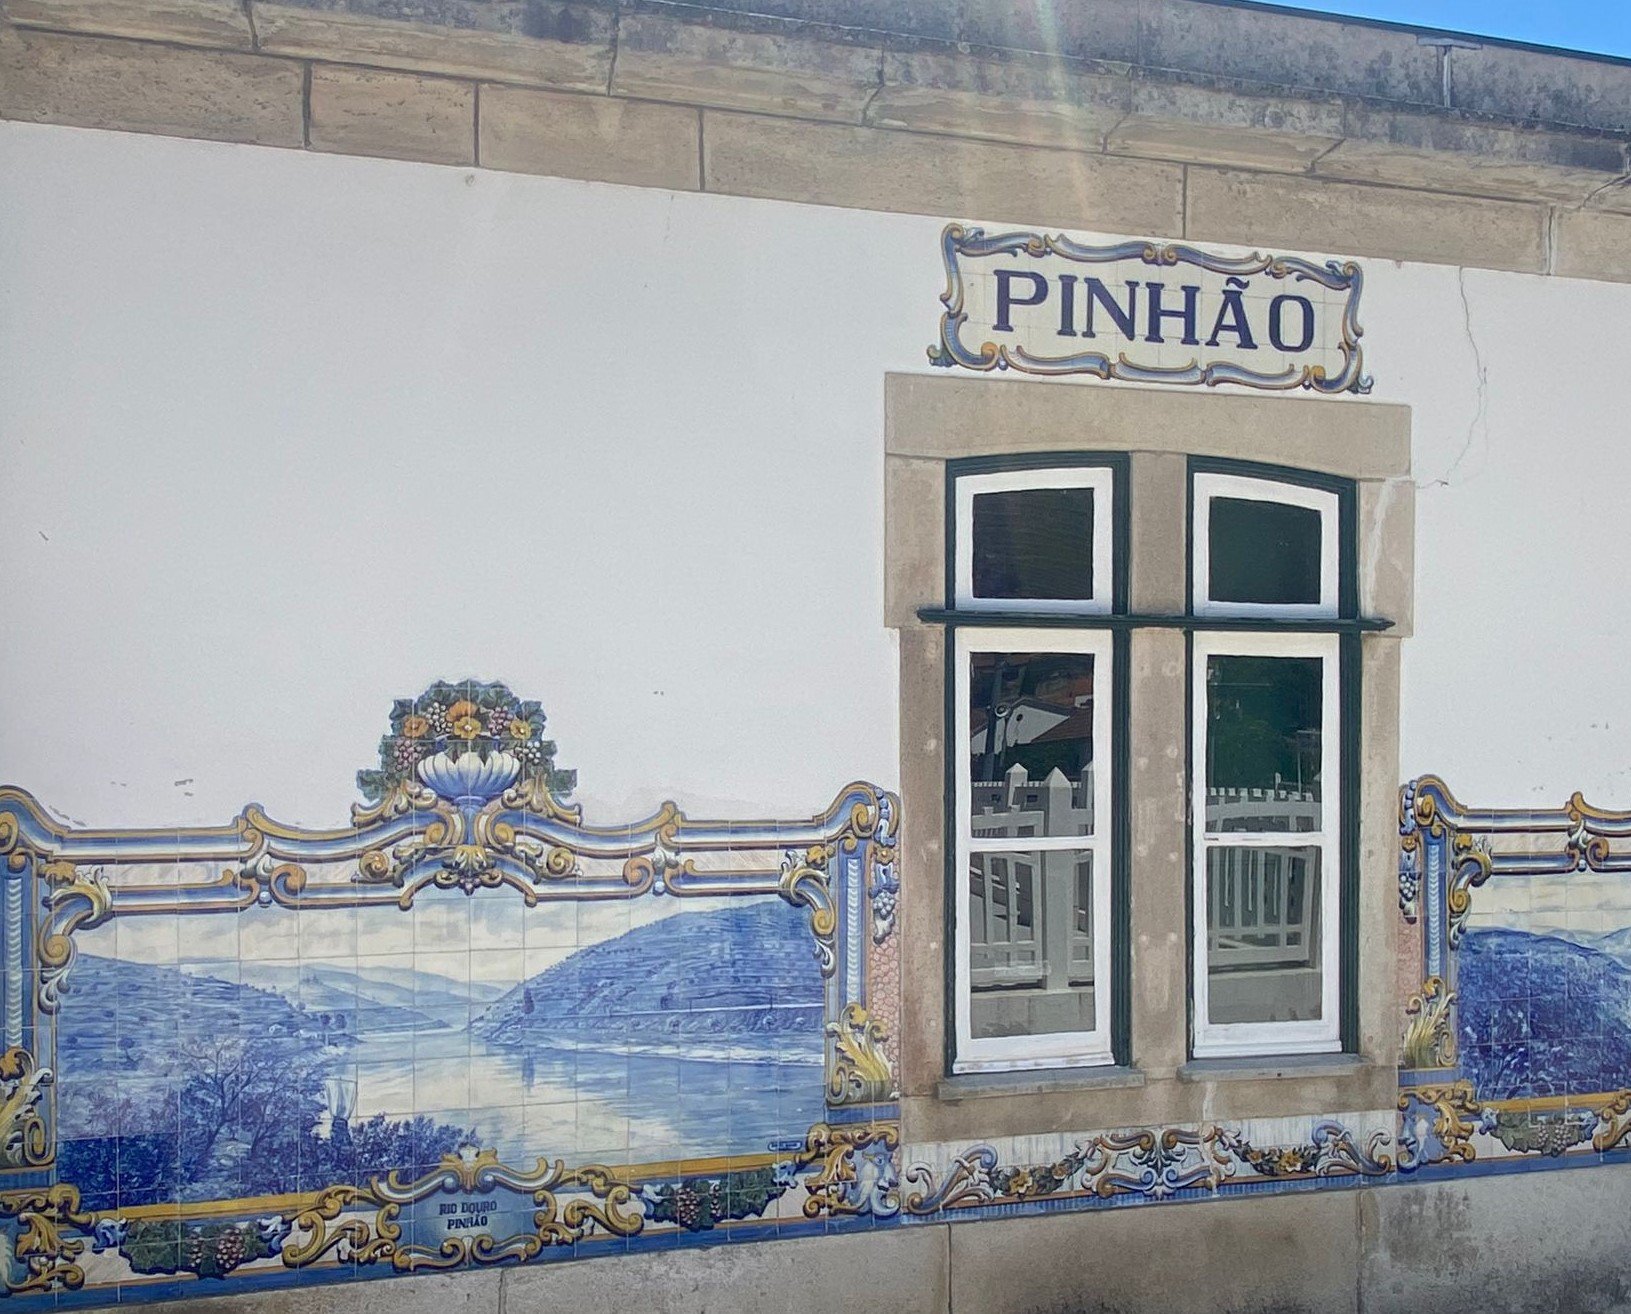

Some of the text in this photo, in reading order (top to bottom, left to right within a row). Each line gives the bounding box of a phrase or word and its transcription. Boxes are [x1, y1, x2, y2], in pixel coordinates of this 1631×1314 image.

[992, 270, 1315, 352] PINHÃO
[439, 1201, 497, 1216] RIO DOURO
[447, 1214, 488, 1229] PINHÃO
